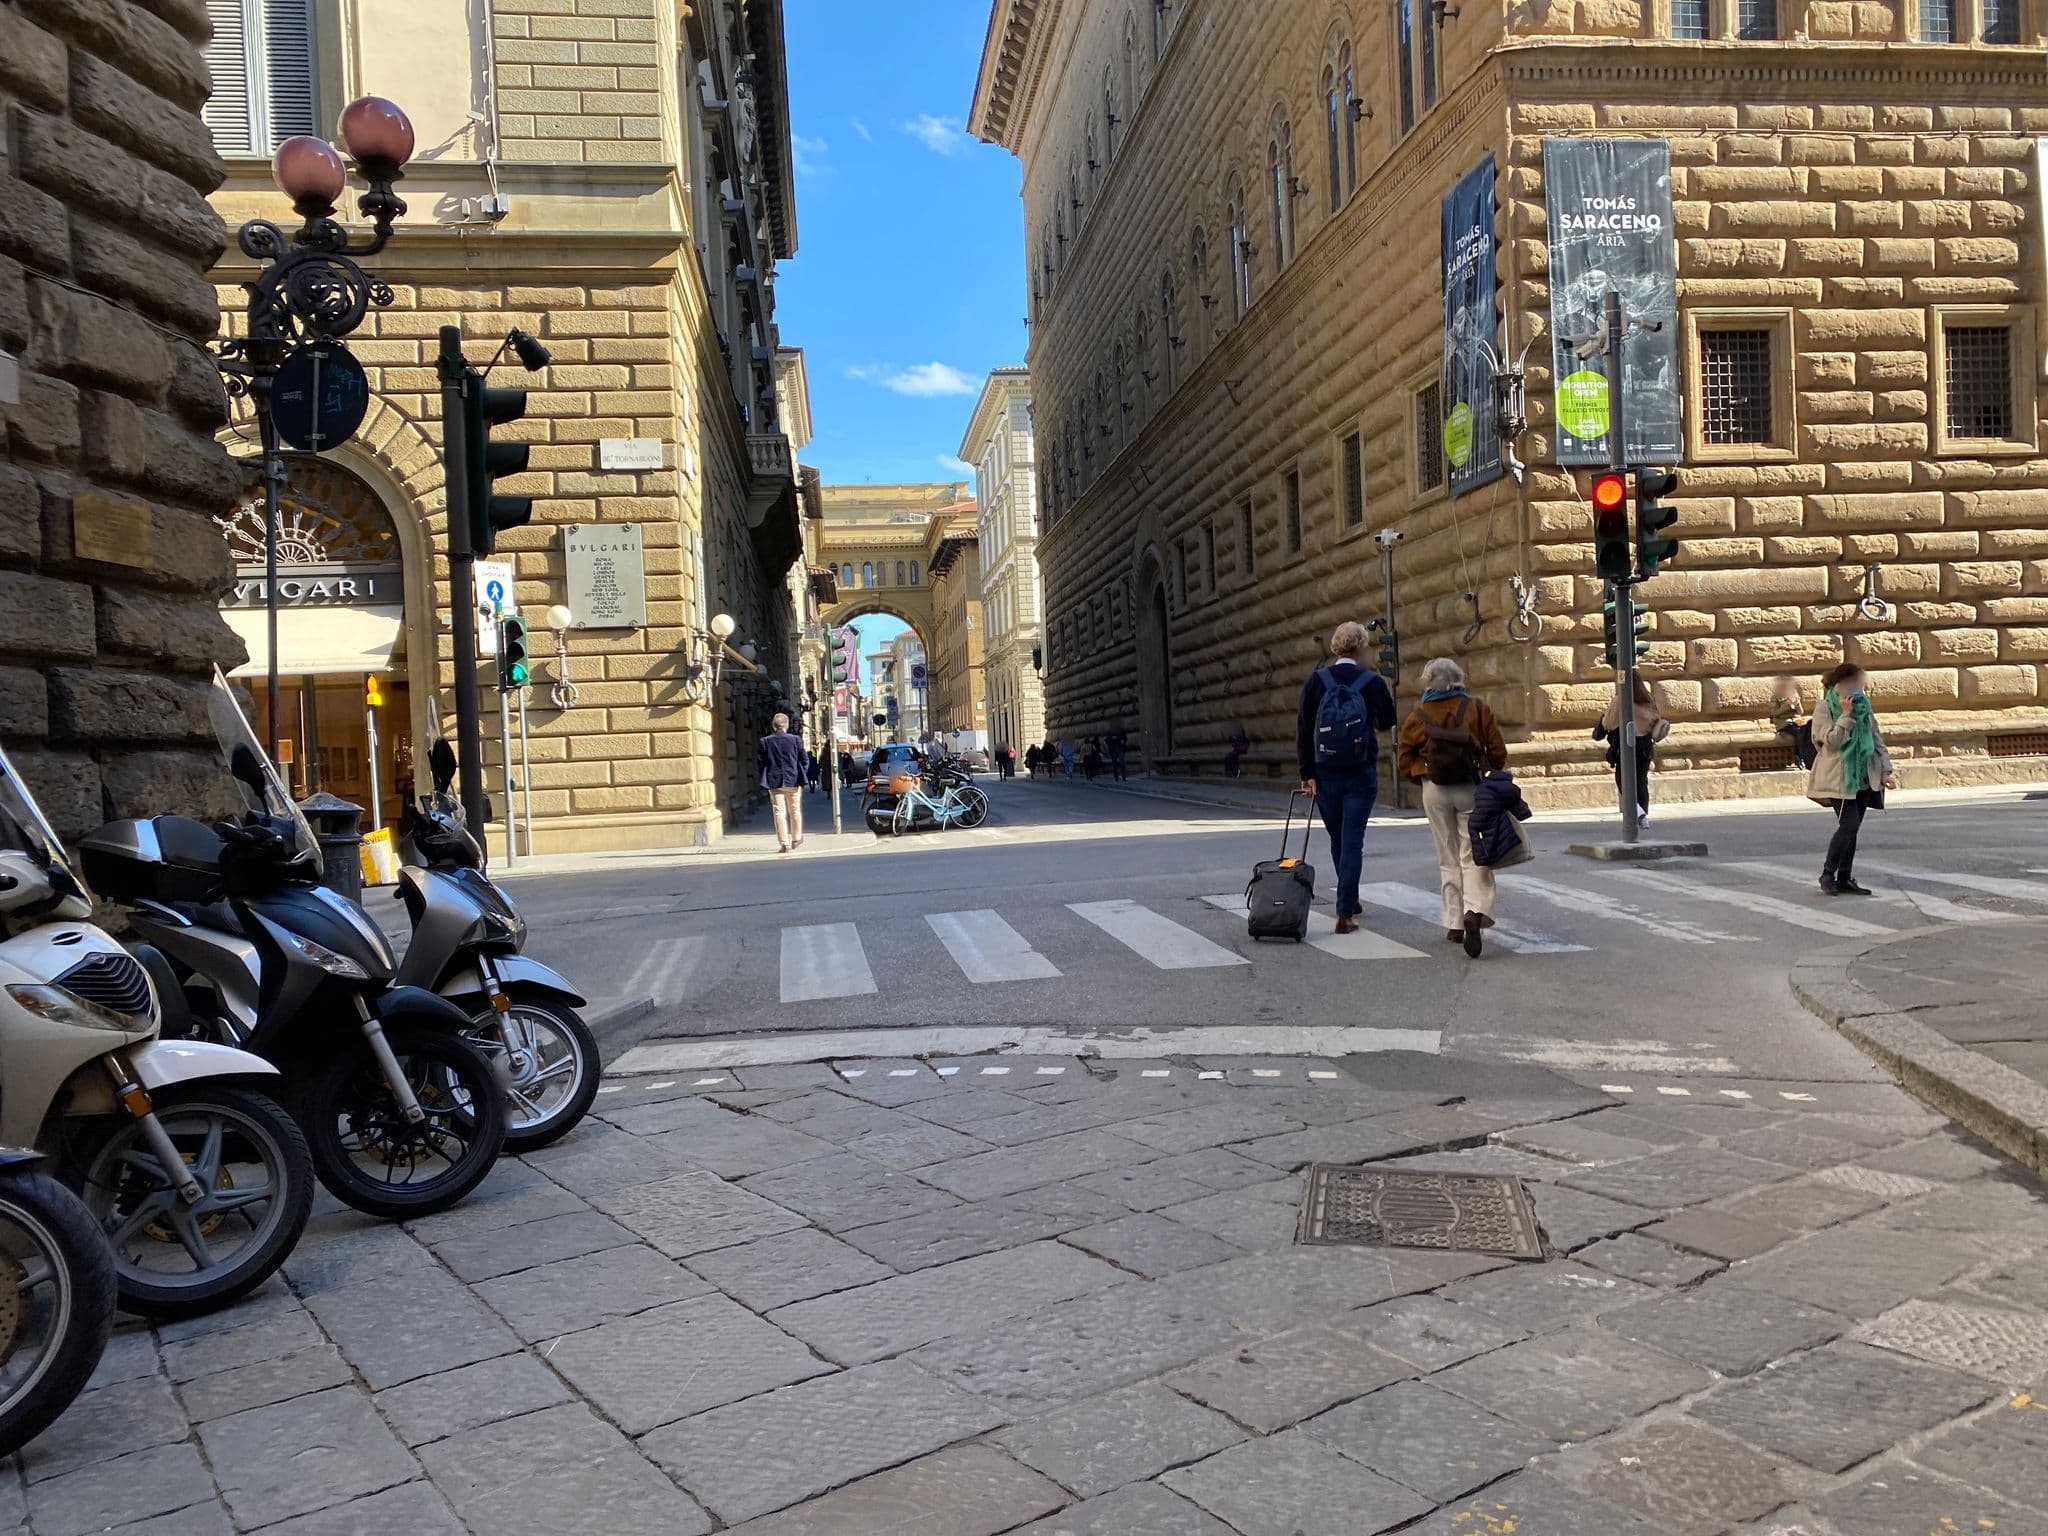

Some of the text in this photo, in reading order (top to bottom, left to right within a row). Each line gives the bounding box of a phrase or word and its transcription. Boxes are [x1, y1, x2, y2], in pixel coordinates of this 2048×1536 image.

[1583, 195, 1636, 210] TOMÁS
[1560, 214, 1661, 229] SARACENO
[1456, 225, 1480, 251] TOMÁS
[1447, 234, 1489, 276] SARACENO
[570, 543, 635, 552] BVLGARI
[233, 579, 376, 599] VLGARI
